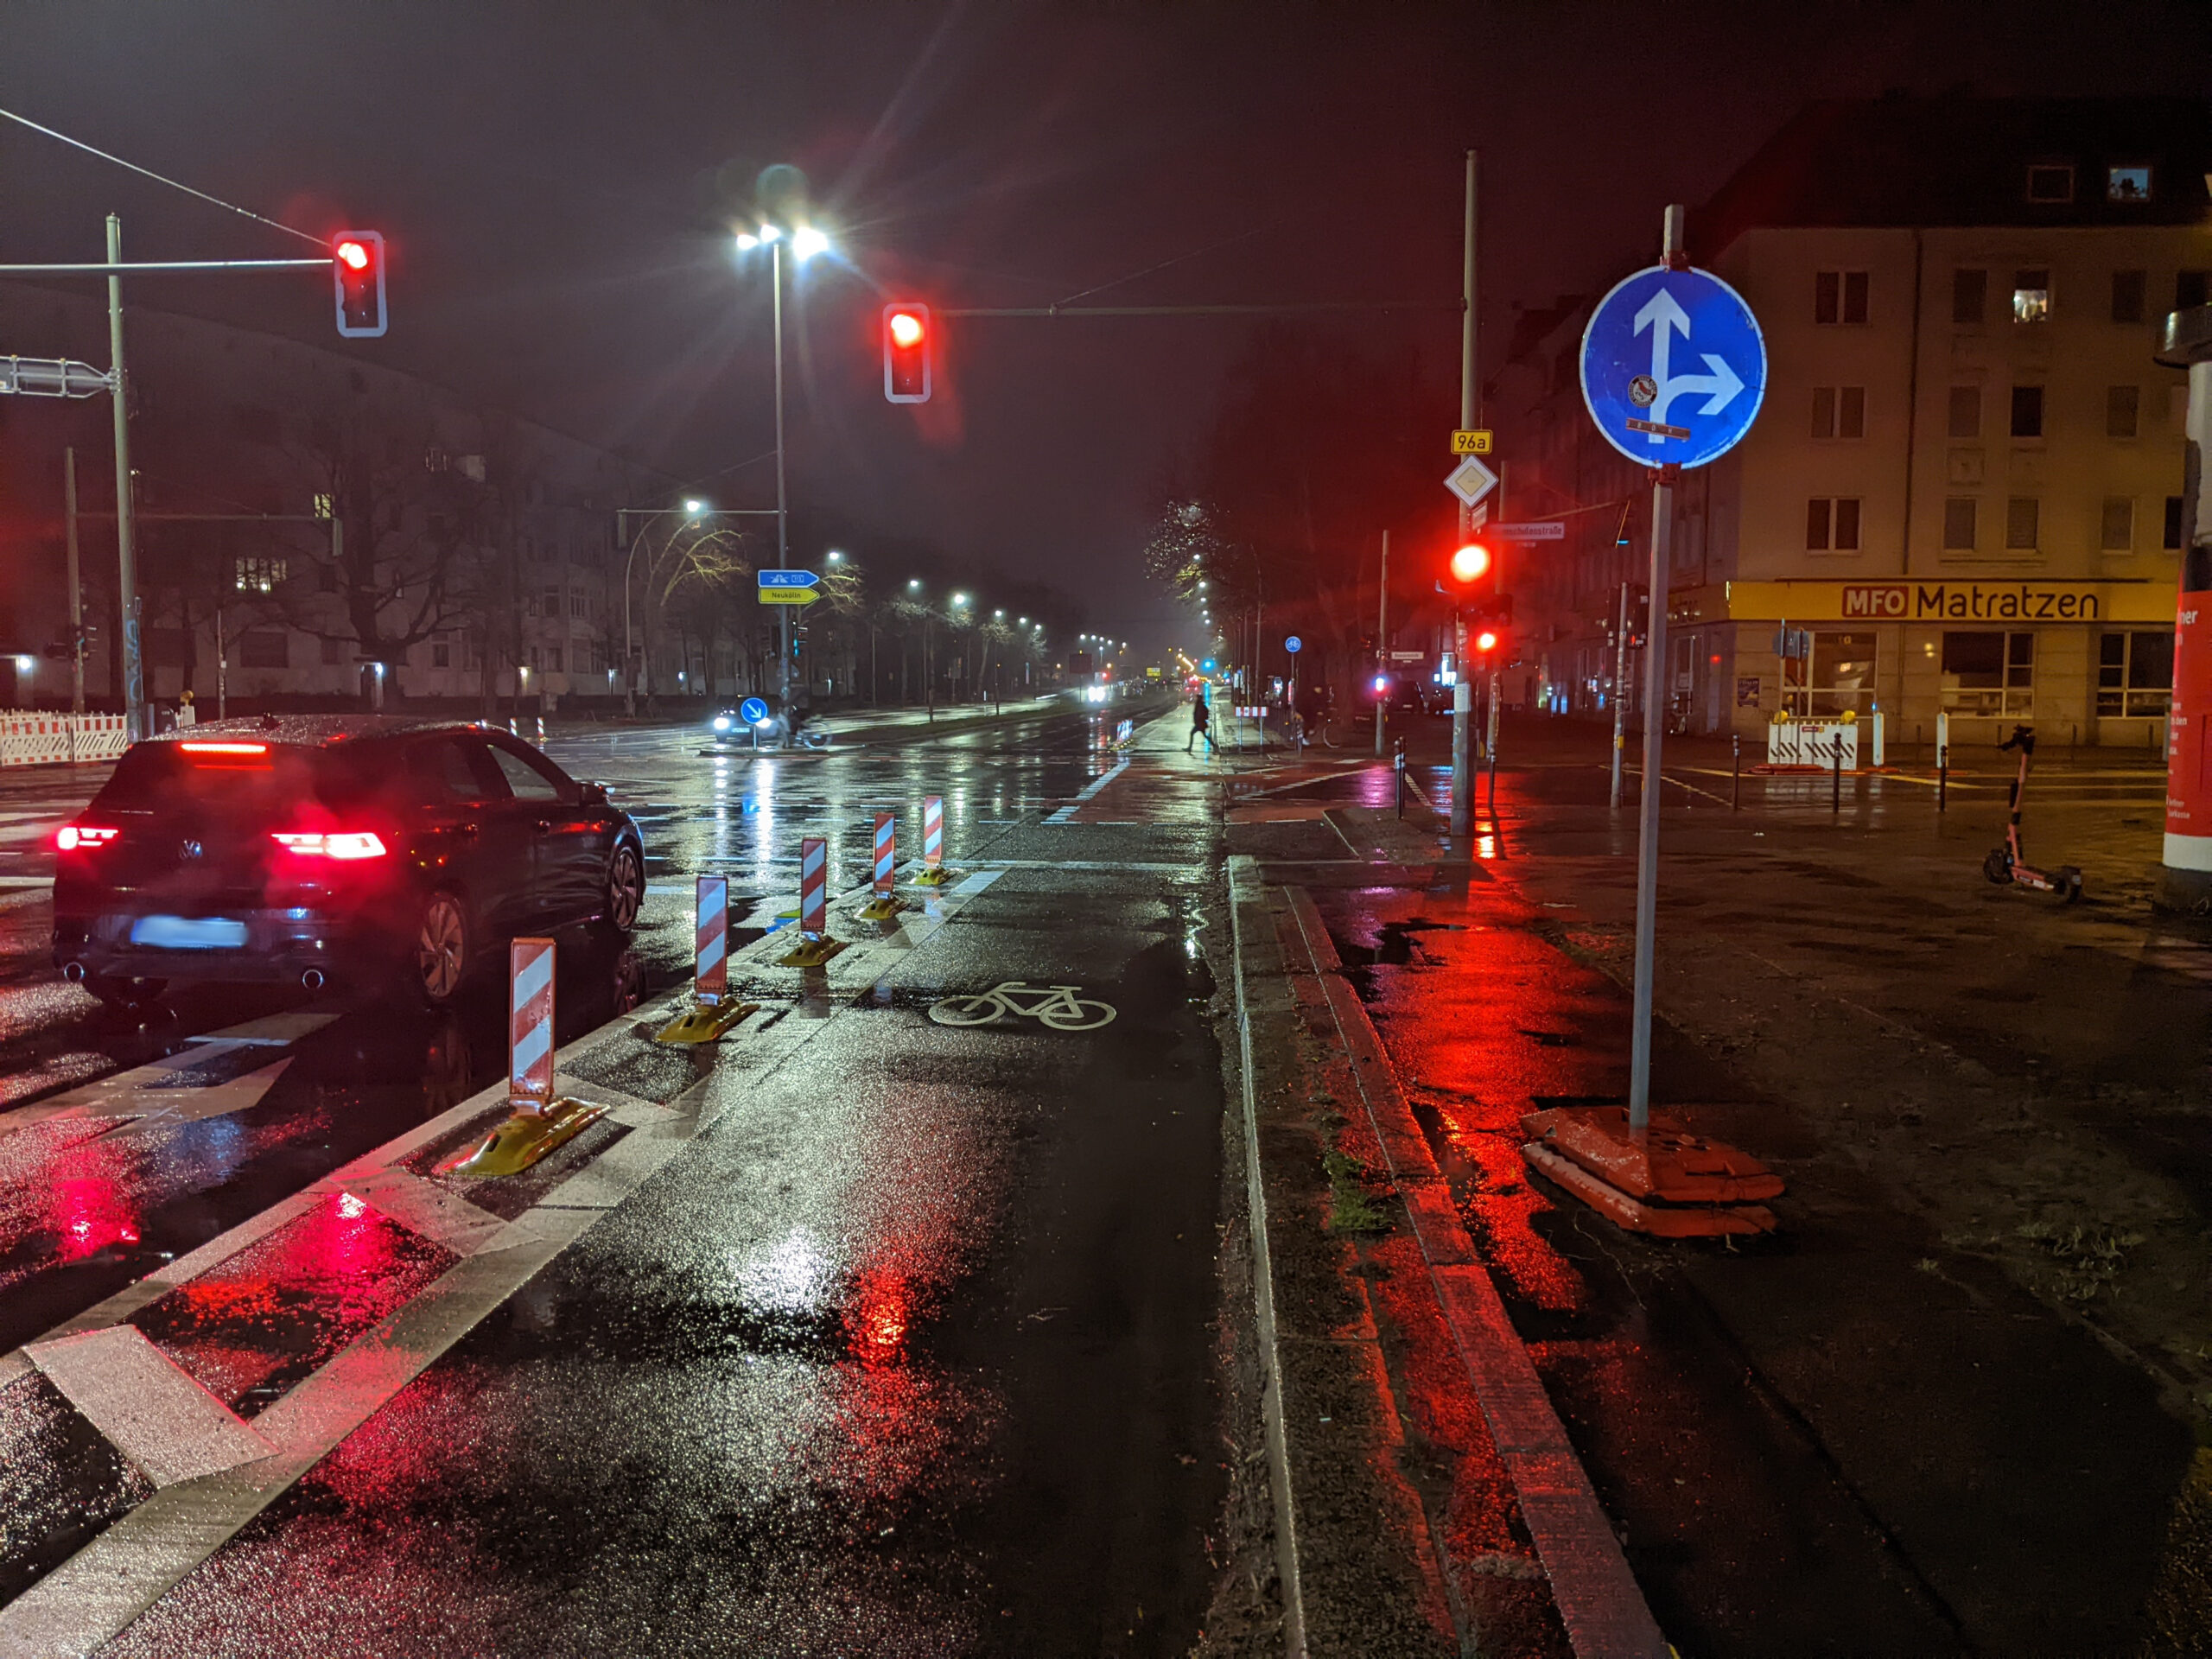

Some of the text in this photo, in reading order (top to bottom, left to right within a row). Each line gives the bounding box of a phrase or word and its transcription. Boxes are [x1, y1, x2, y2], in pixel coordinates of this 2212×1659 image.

[1458, 435, 1486, 449] 96a
[1846, 585, 2099, 619] MFO Matratzen
